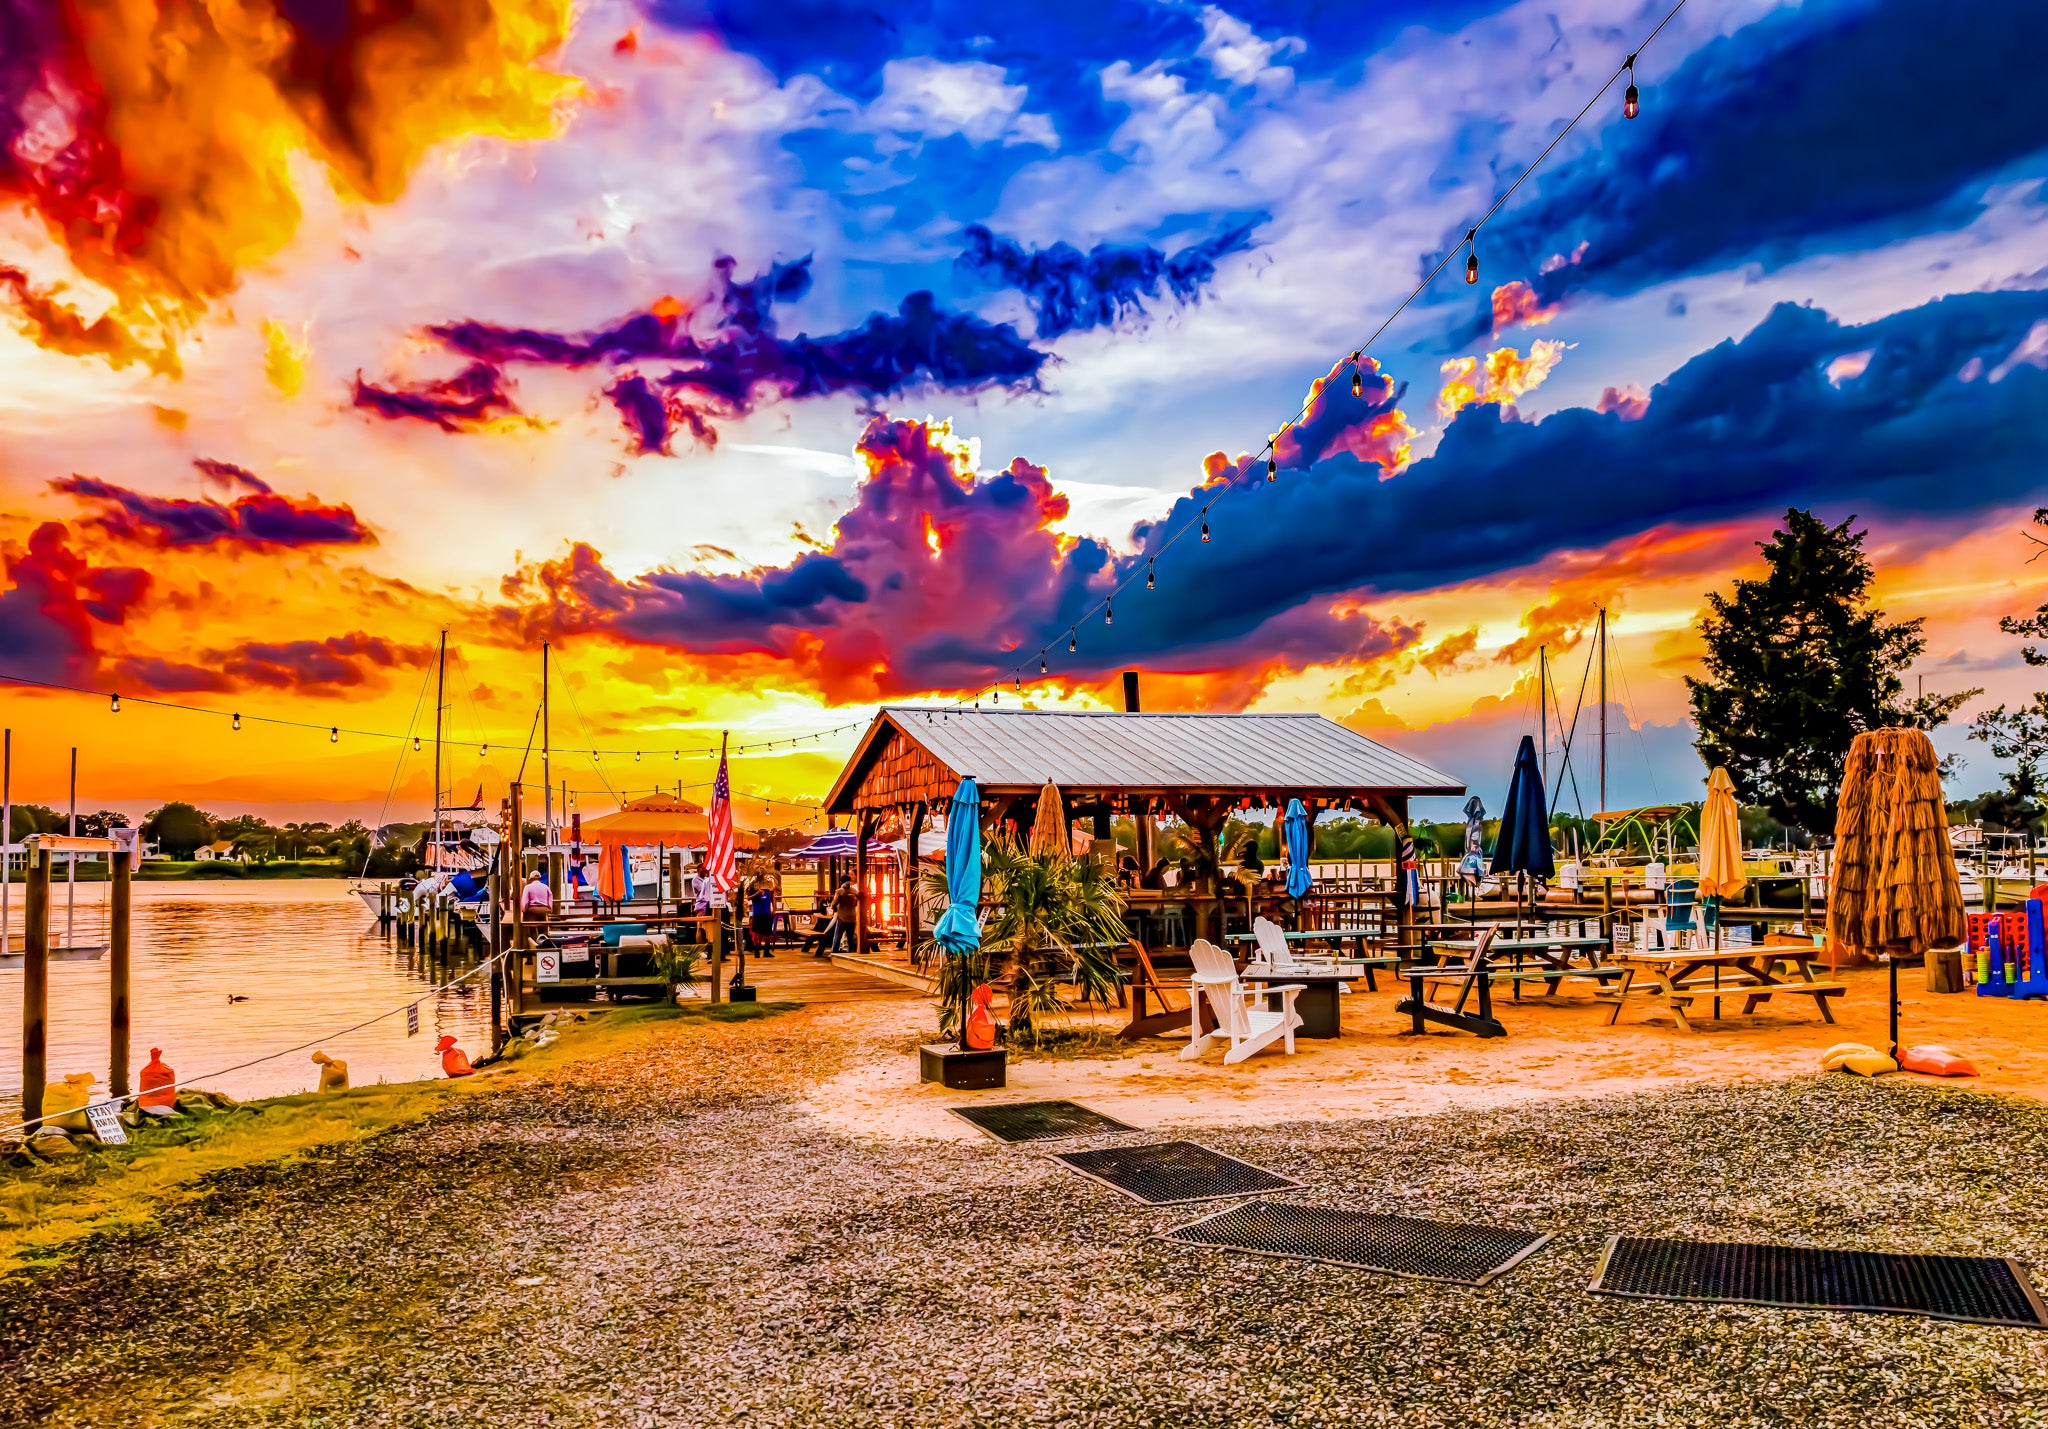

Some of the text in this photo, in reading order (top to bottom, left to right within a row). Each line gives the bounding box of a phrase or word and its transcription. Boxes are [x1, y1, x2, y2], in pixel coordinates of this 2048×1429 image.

[88, 1106, 112, 1118] STAY
[95, 1117, 117, 1128] AWAY
[103, 1134, 126, 1145] ROCKS
